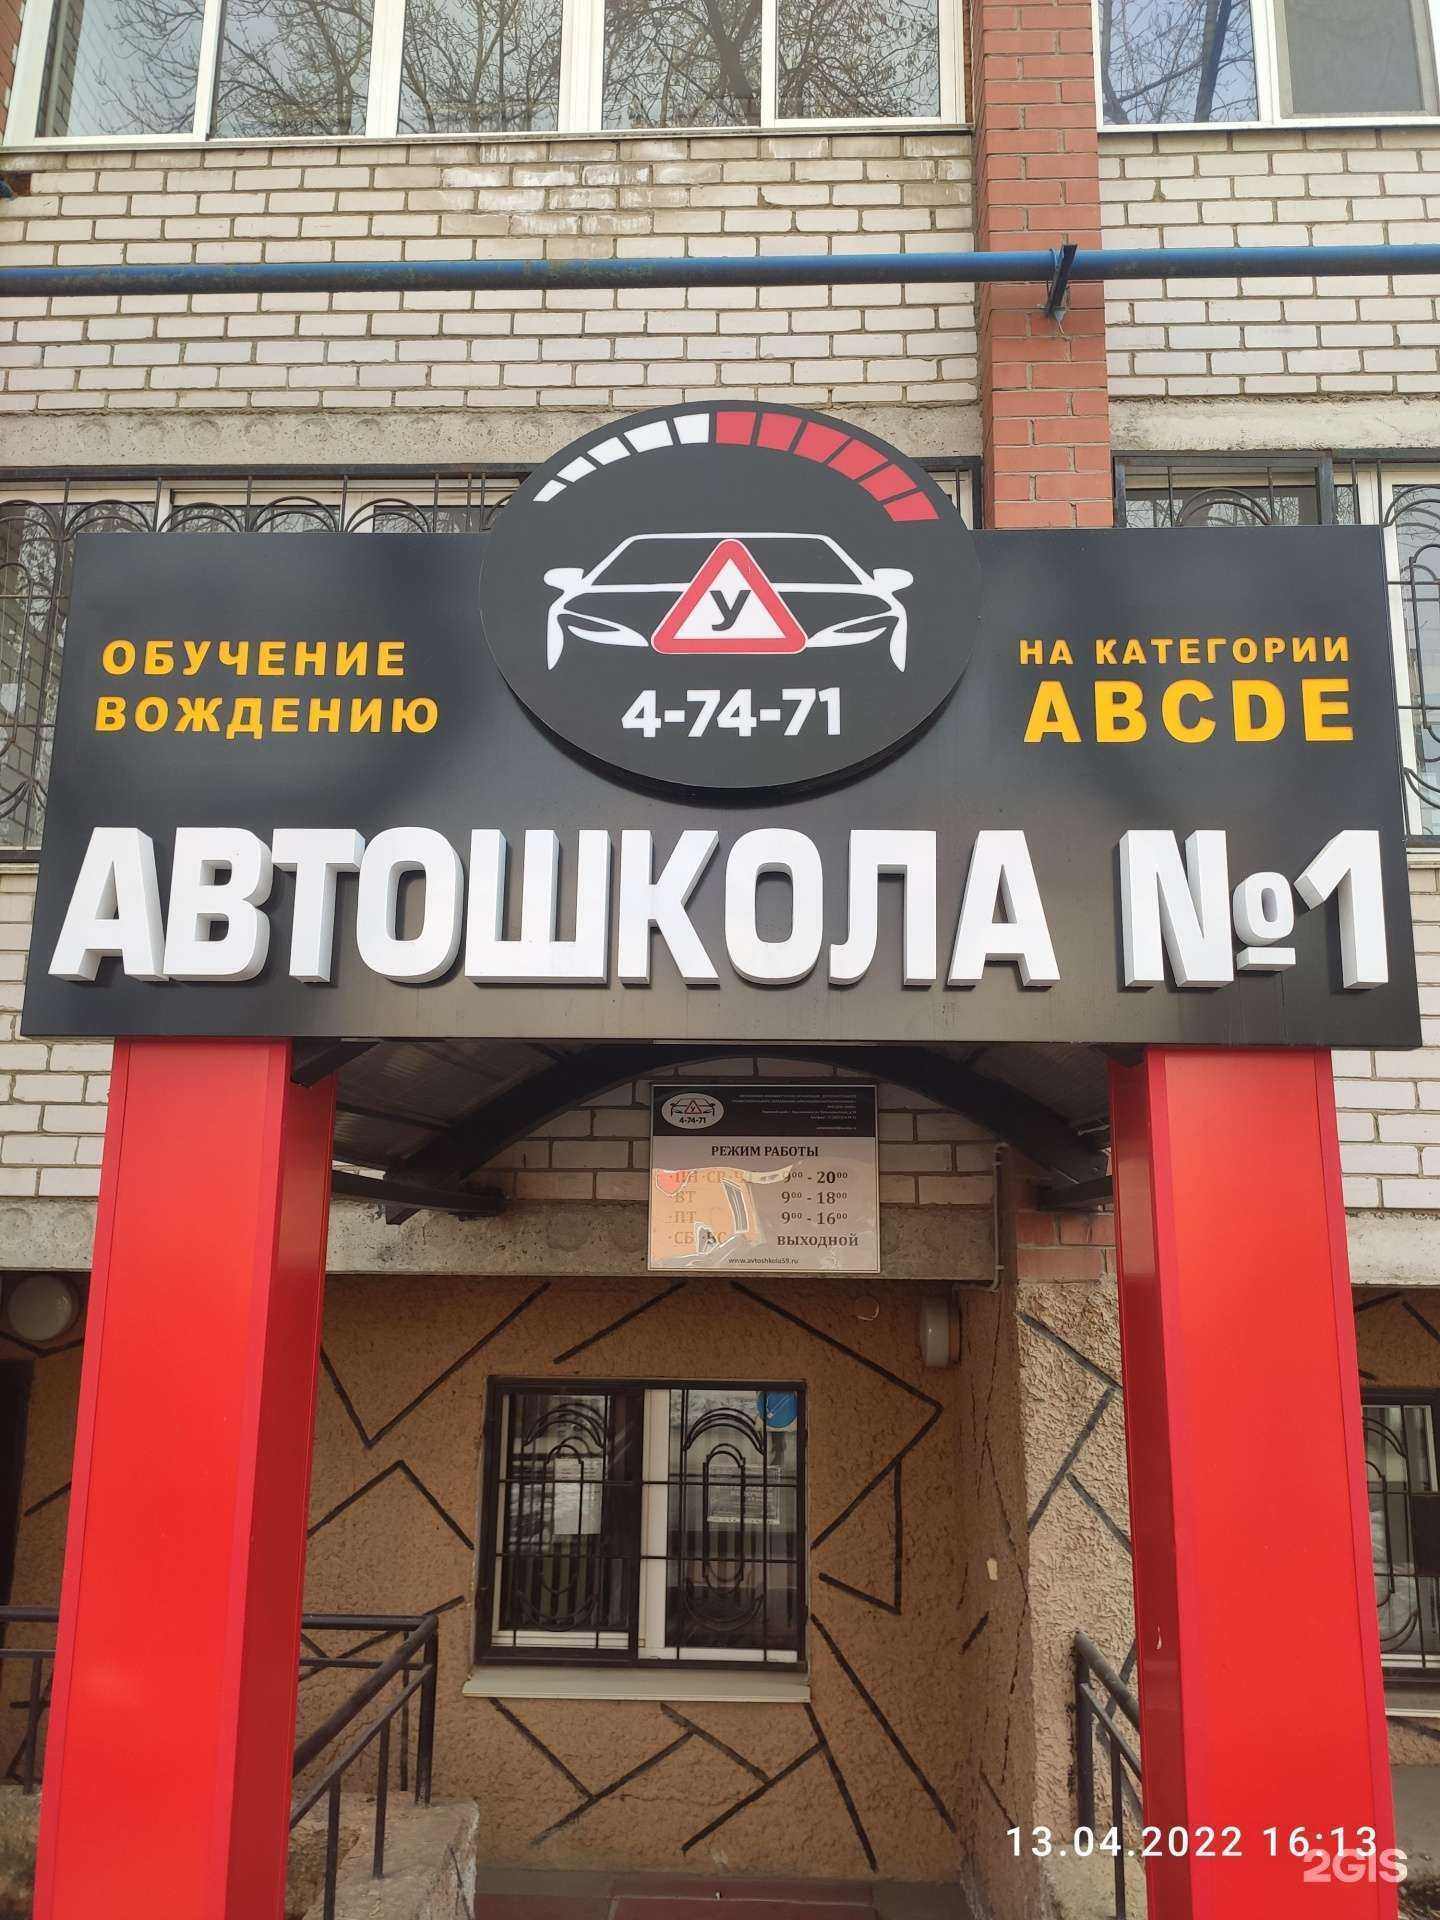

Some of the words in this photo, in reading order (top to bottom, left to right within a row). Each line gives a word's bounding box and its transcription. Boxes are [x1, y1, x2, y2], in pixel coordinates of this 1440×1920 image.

[102, 640, 406, 677] ОБУЧЕНИЕ
[1019, 640, 1074, 665] НА
[1095, 636, 1350, 665] КАТЕГОРИИ
[95, 696, 439, 739] ВОЖДЕНИЮ
[621, 687, 841, 738] 4-74-71
[1024, 678, 1354, 743] ABCDE
[48, 827, 1061, 986] АВТОШКОЛА
[679, 1116, 707, 1124] 4-74-71
[711, 1145, 761, 1157] РЕЖИМ
[764, 1146, 819, 1157] РАБОТЫ
